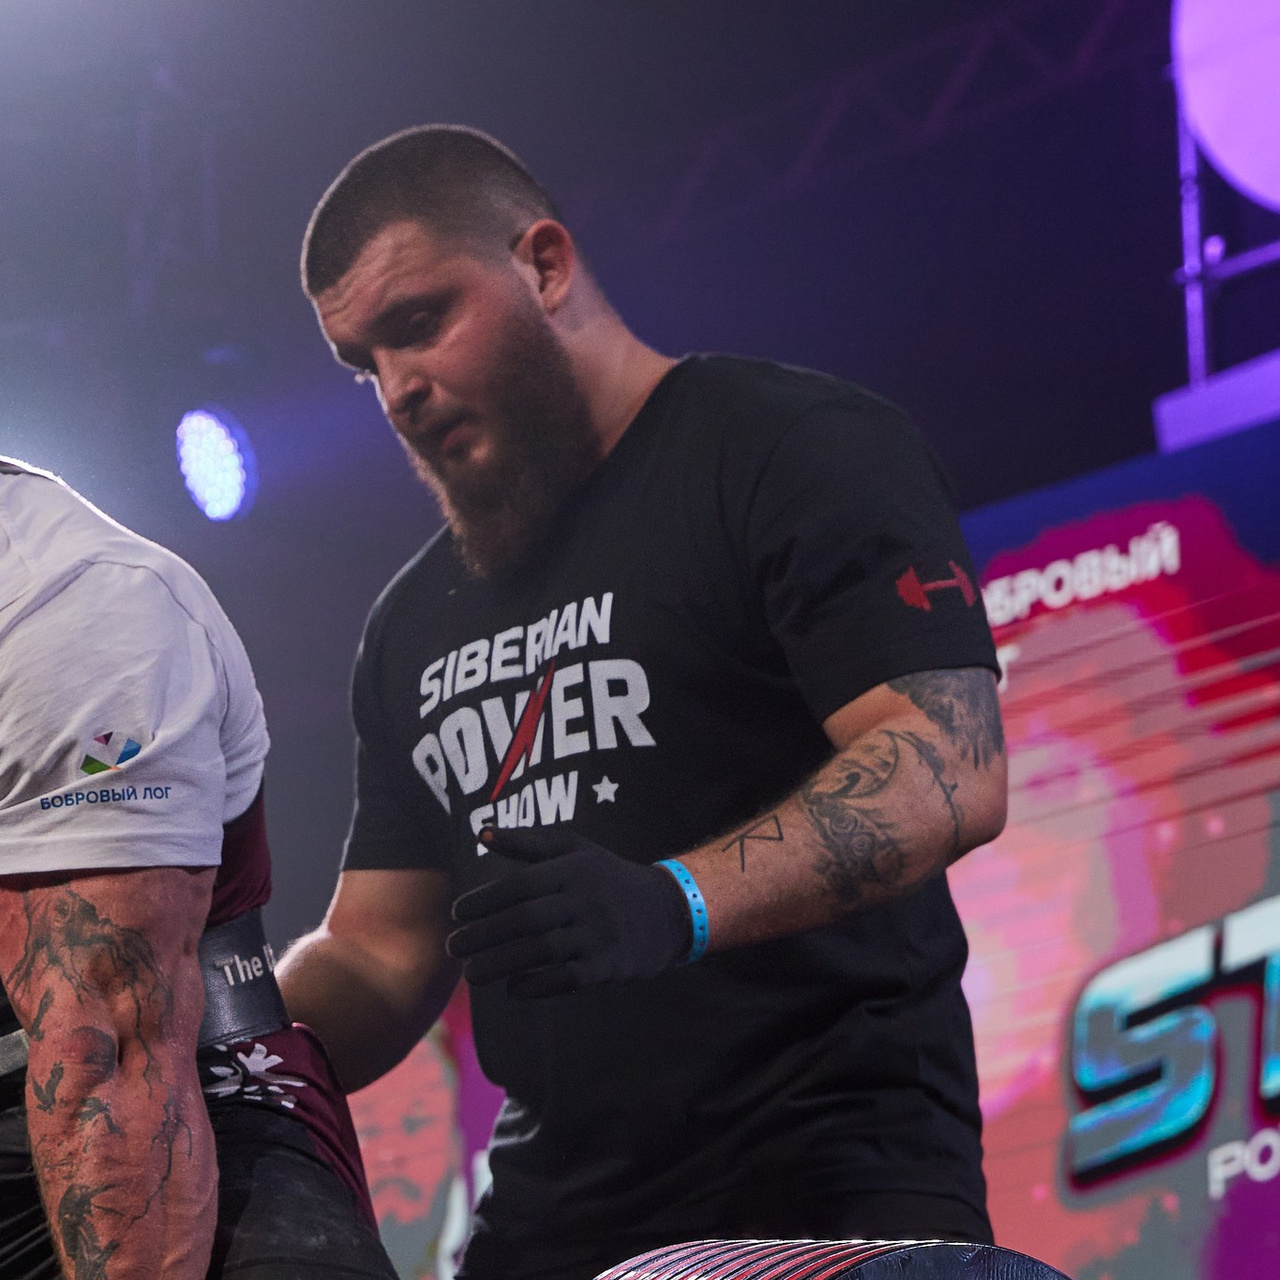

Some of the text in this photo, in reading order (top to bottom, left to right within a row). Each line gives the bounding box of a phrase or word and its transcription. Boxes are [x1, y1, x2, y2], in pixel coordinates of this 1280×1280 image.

[420, 592, 613, 719] SIBERIAN
[412, 659, 657, 815] POWER
[40, 786, 172, 810] БОБРОВЫЙ ЛОГ
[215, 954, 263, 986] The
